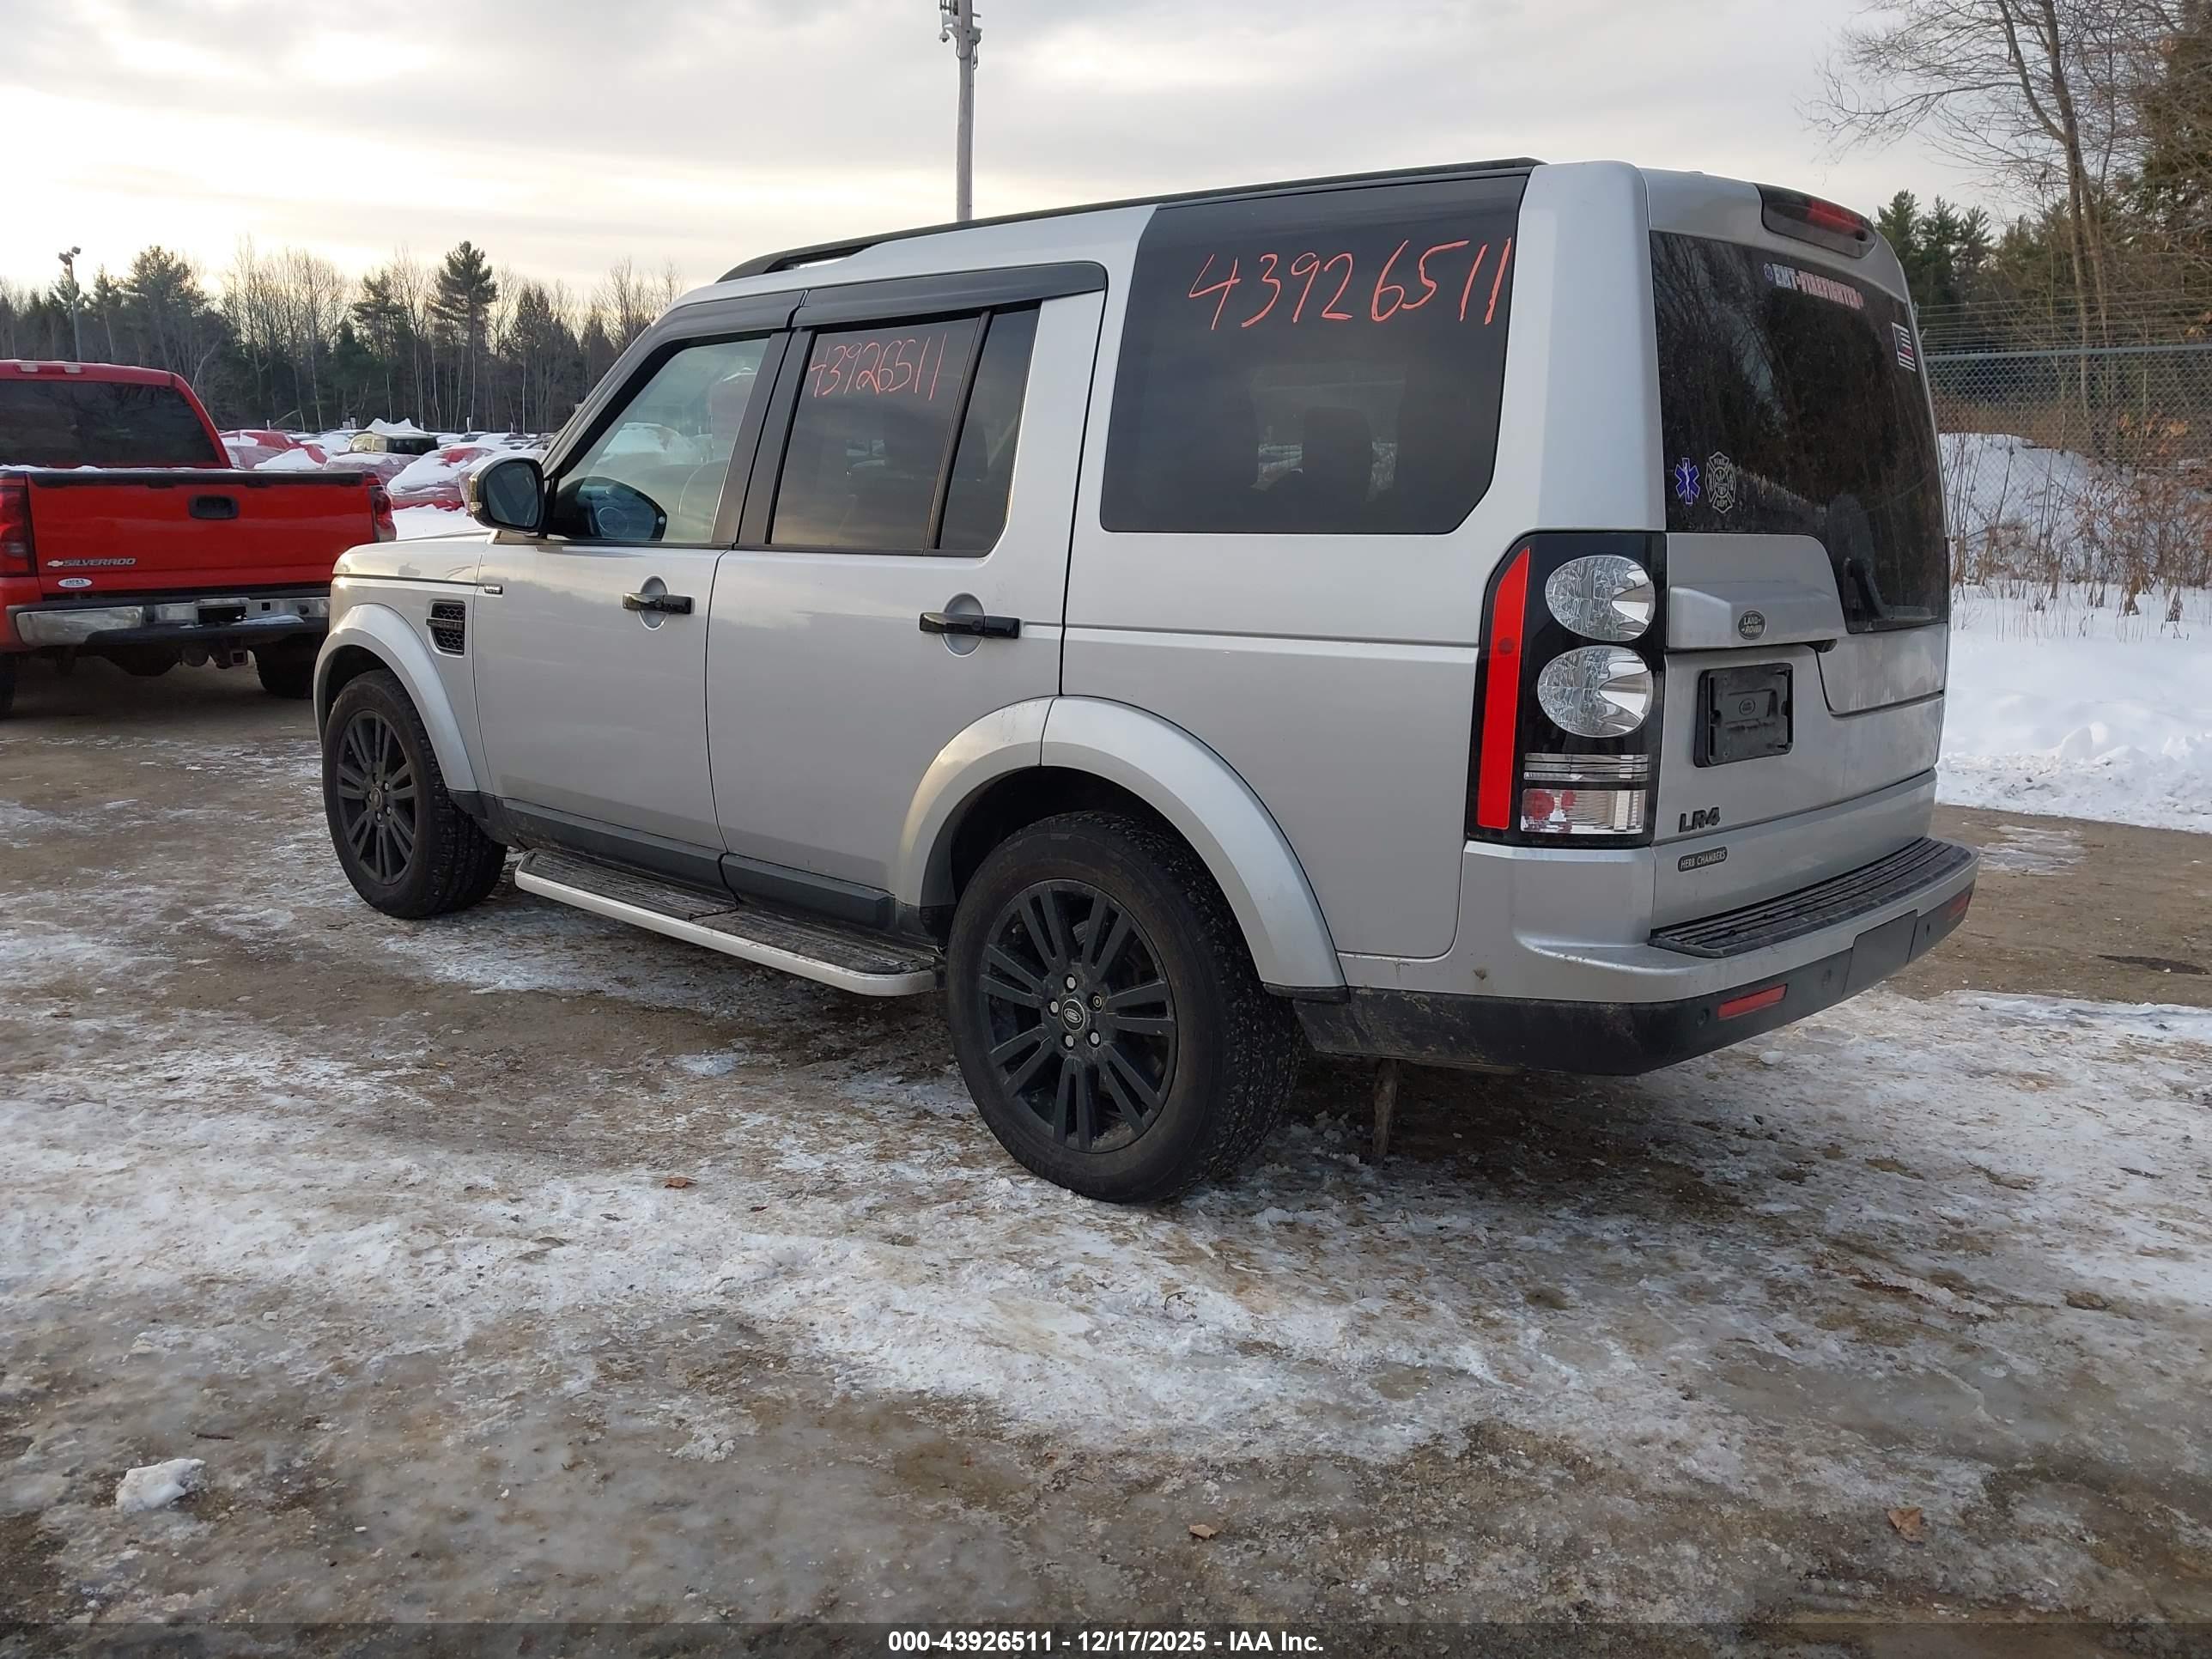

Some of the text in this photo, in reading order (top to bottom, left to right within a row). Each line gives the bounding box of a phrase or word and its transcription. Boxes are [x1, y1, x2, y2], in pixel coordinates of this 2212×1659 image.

[1188, 236, 1512, 331] 43926511
[810, 331, 947, 401] 43926511
[63, 557, 137, 568] SILVERADO
[1679, 806, 1721, 833] LR4
[1680, 850, 1726, 869] HERB CHAMBERS
